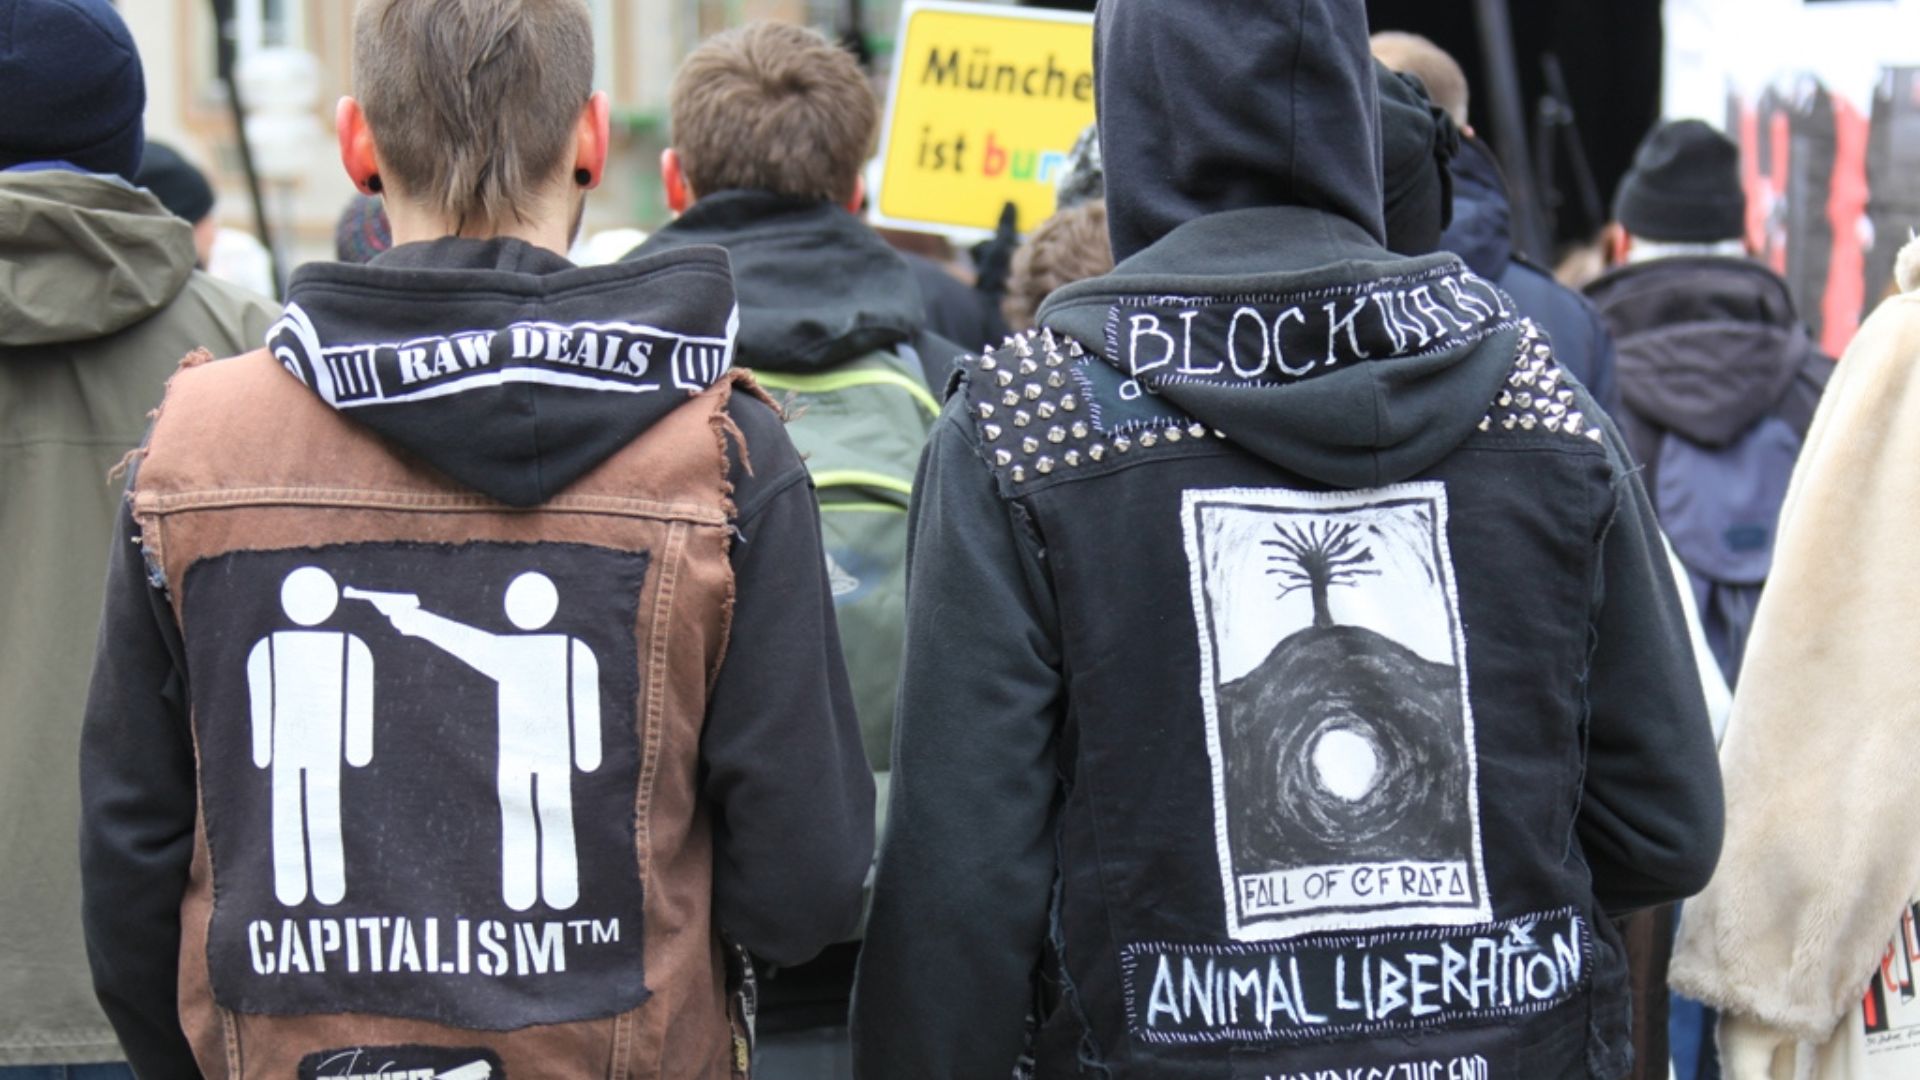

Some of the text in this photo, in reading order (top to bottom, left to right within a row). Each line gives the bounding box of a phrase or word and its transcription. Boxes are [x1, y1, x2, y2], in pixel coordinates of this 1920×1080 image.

[920, 47, 1093, 102] Münche
[917, 126, 966, 173] ist
[396, 326, 653, 386] RAW DEALS
[1243, 876, 1295, 910] FALL
[1303, 868, 1345, 900] OF
[1146, 953, 1328, 1032] ANIMAL
